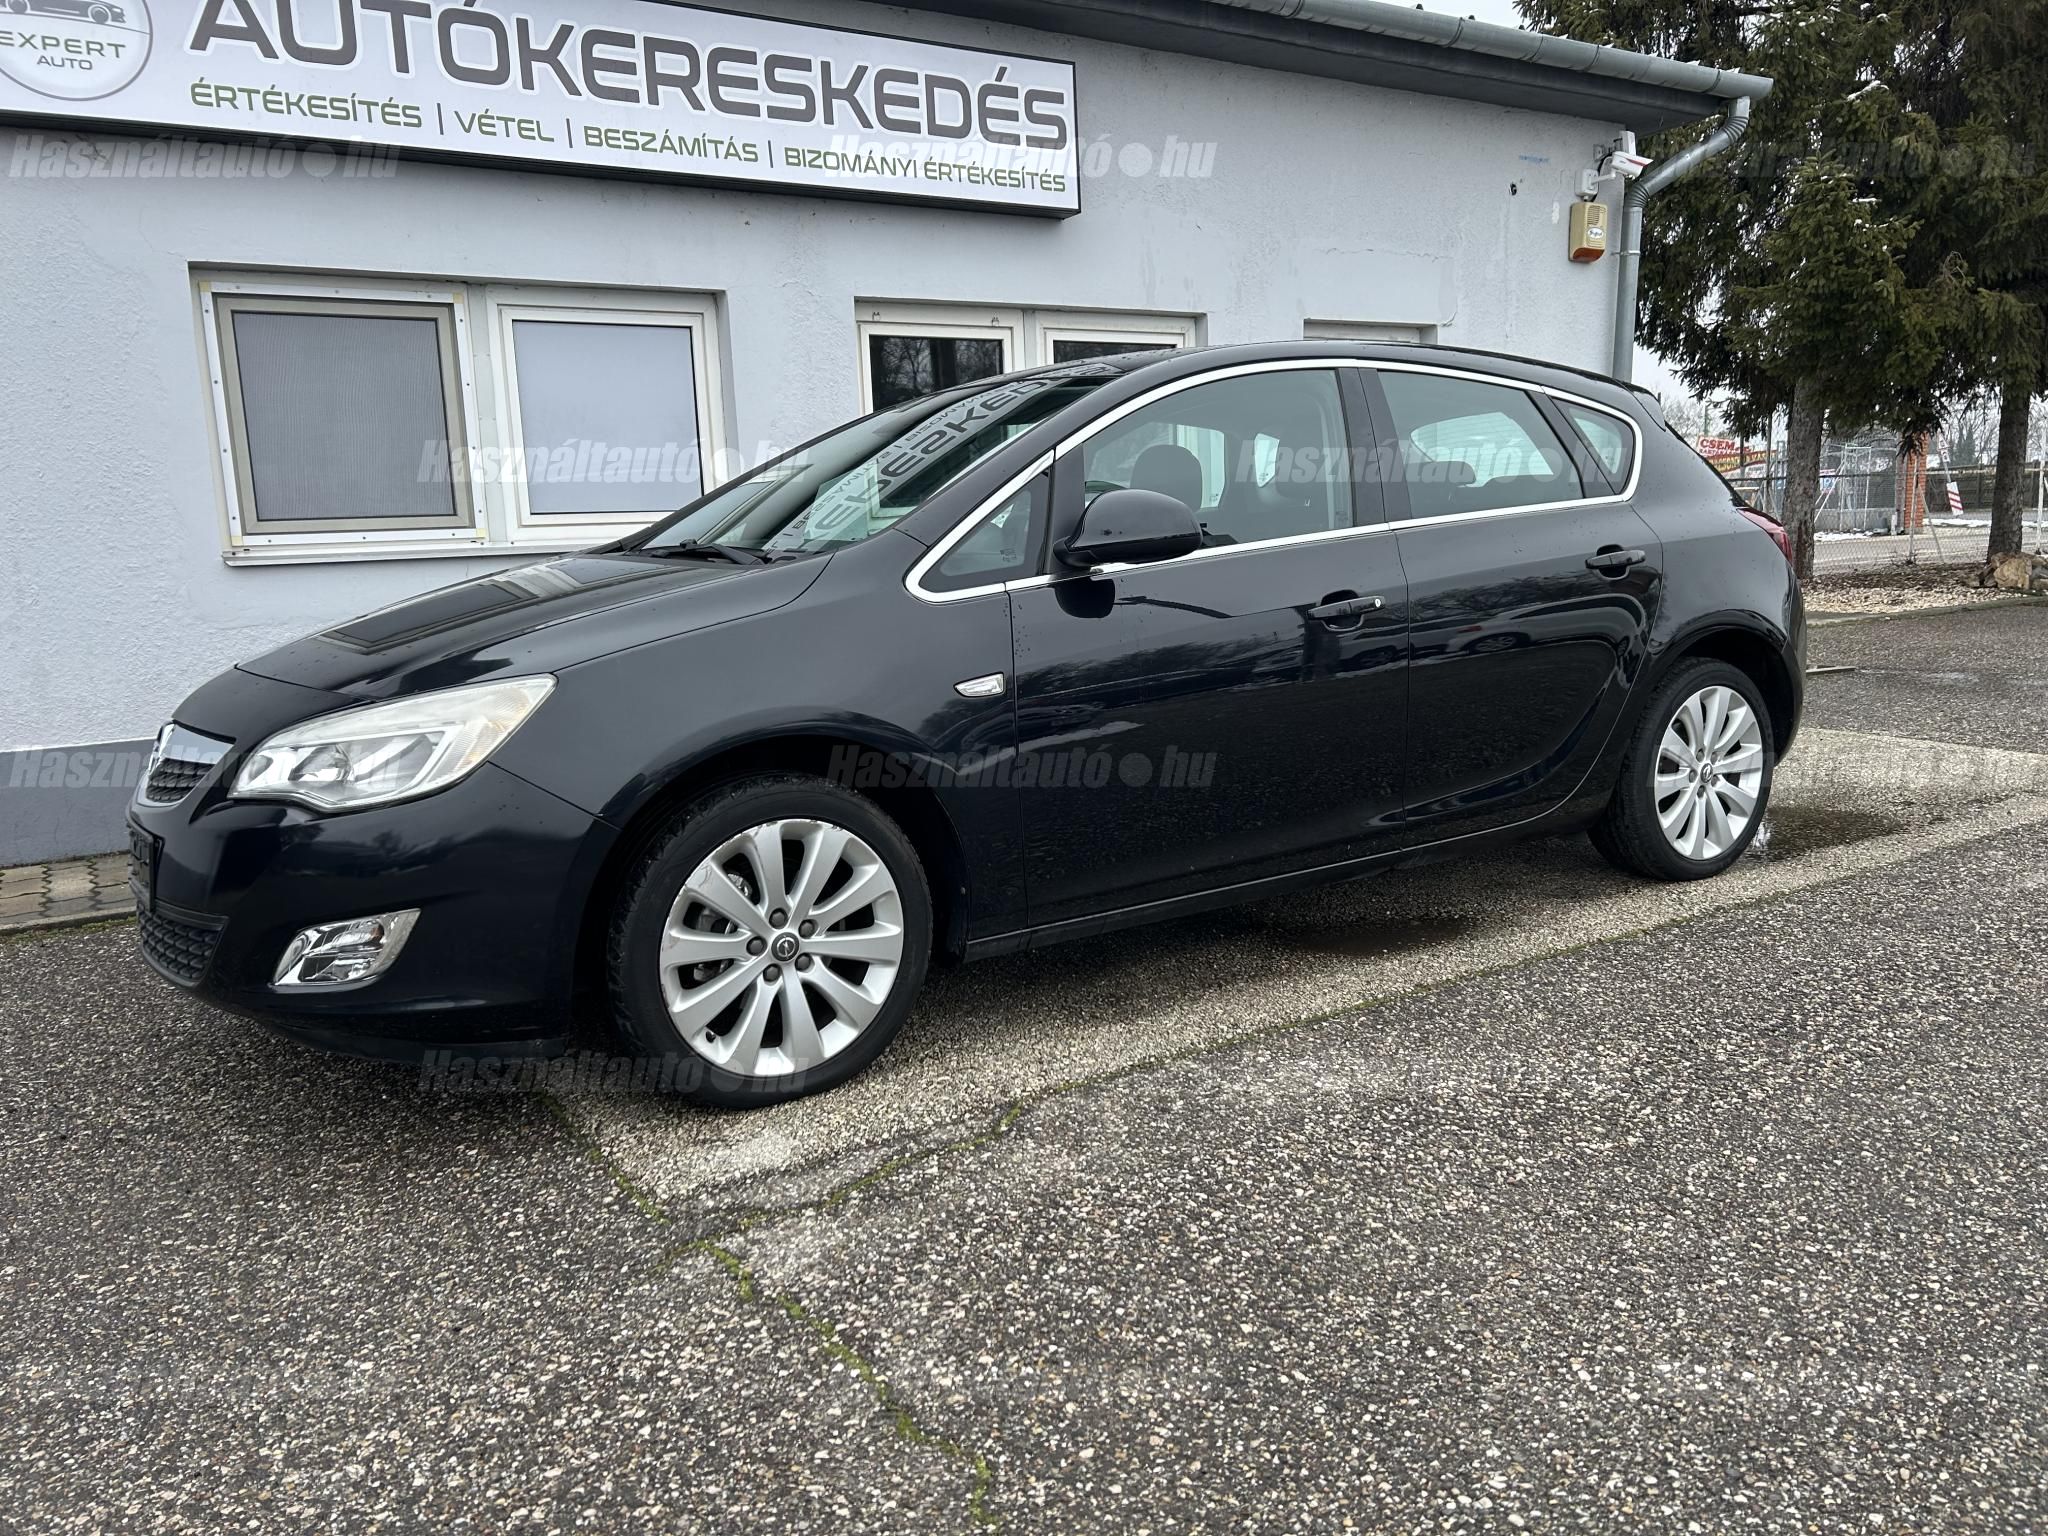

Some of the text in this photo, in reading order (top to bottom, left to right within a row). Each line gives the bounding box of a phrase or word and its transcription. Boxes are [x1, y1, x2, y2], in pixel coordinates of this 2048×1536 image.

[0, 31, 126, 58] EXPERT
[37, 55, 93, 70] AUTO
[190, 0, 1067, 150] AUTÓKERESKEDÉS
[190, 77, 1066, 192] ÉRTÉKESÍTÉS VÉTEL BESZÁMÍTÁS BIZOMÁNYI ÉRTÉKESÍTÉS
